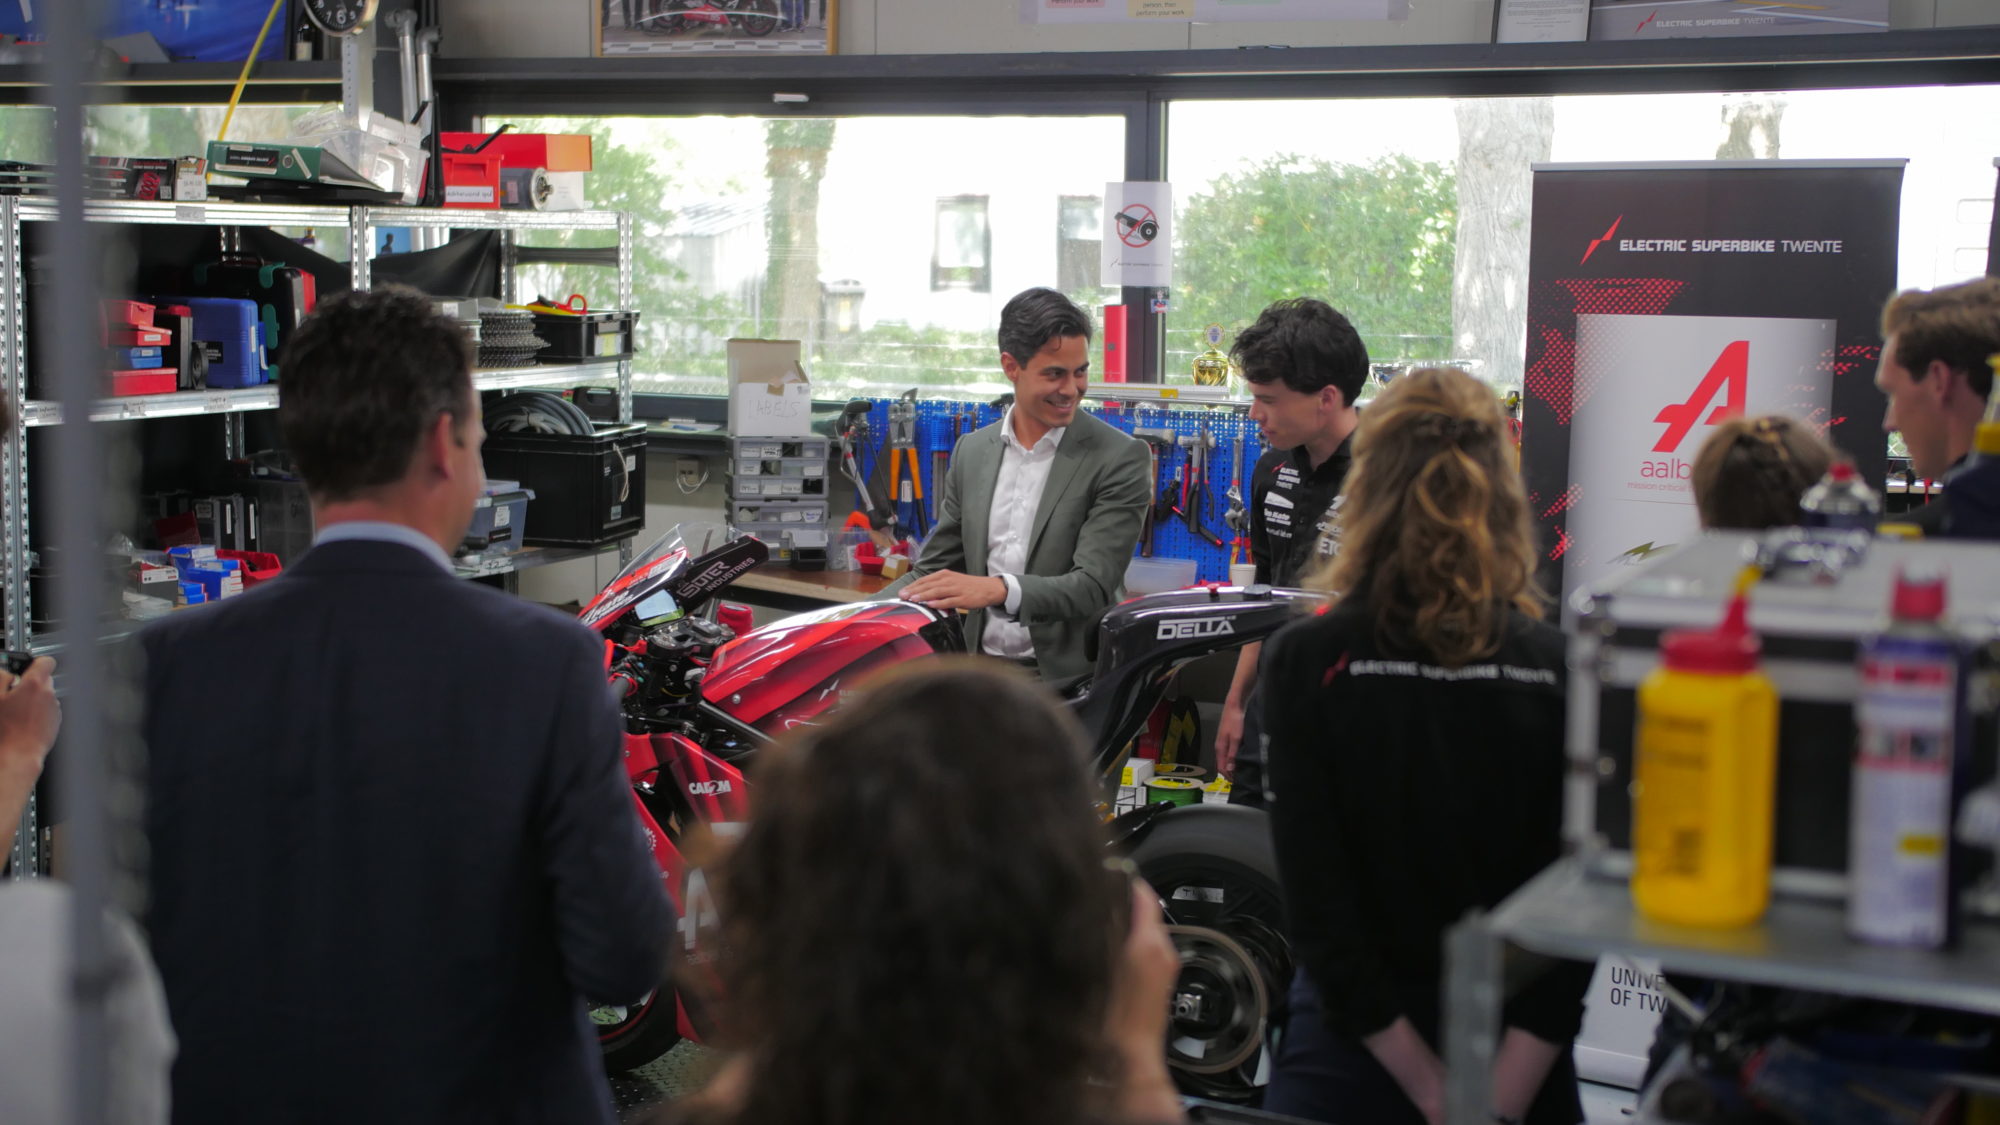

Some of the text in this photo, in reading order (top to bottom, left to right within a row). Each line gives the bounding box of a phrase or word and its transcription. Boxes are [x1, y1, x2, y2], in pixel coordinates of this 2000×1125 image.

[336, 10, 346, 24] 6
[1656, 17, 1776, 28] ELECTRIC SUPERBIKE TWENTE
[1619, 240, 1843, 253] ELECTRIC SUPERBIKE TWENTE
[676, 560, 731, 598] SUTER
[706, 557, 756, 592] INDUSTRIES
[1156, 617, 1235, 640] DELTA
[1611, 987, 1666, 1013] OF TW
